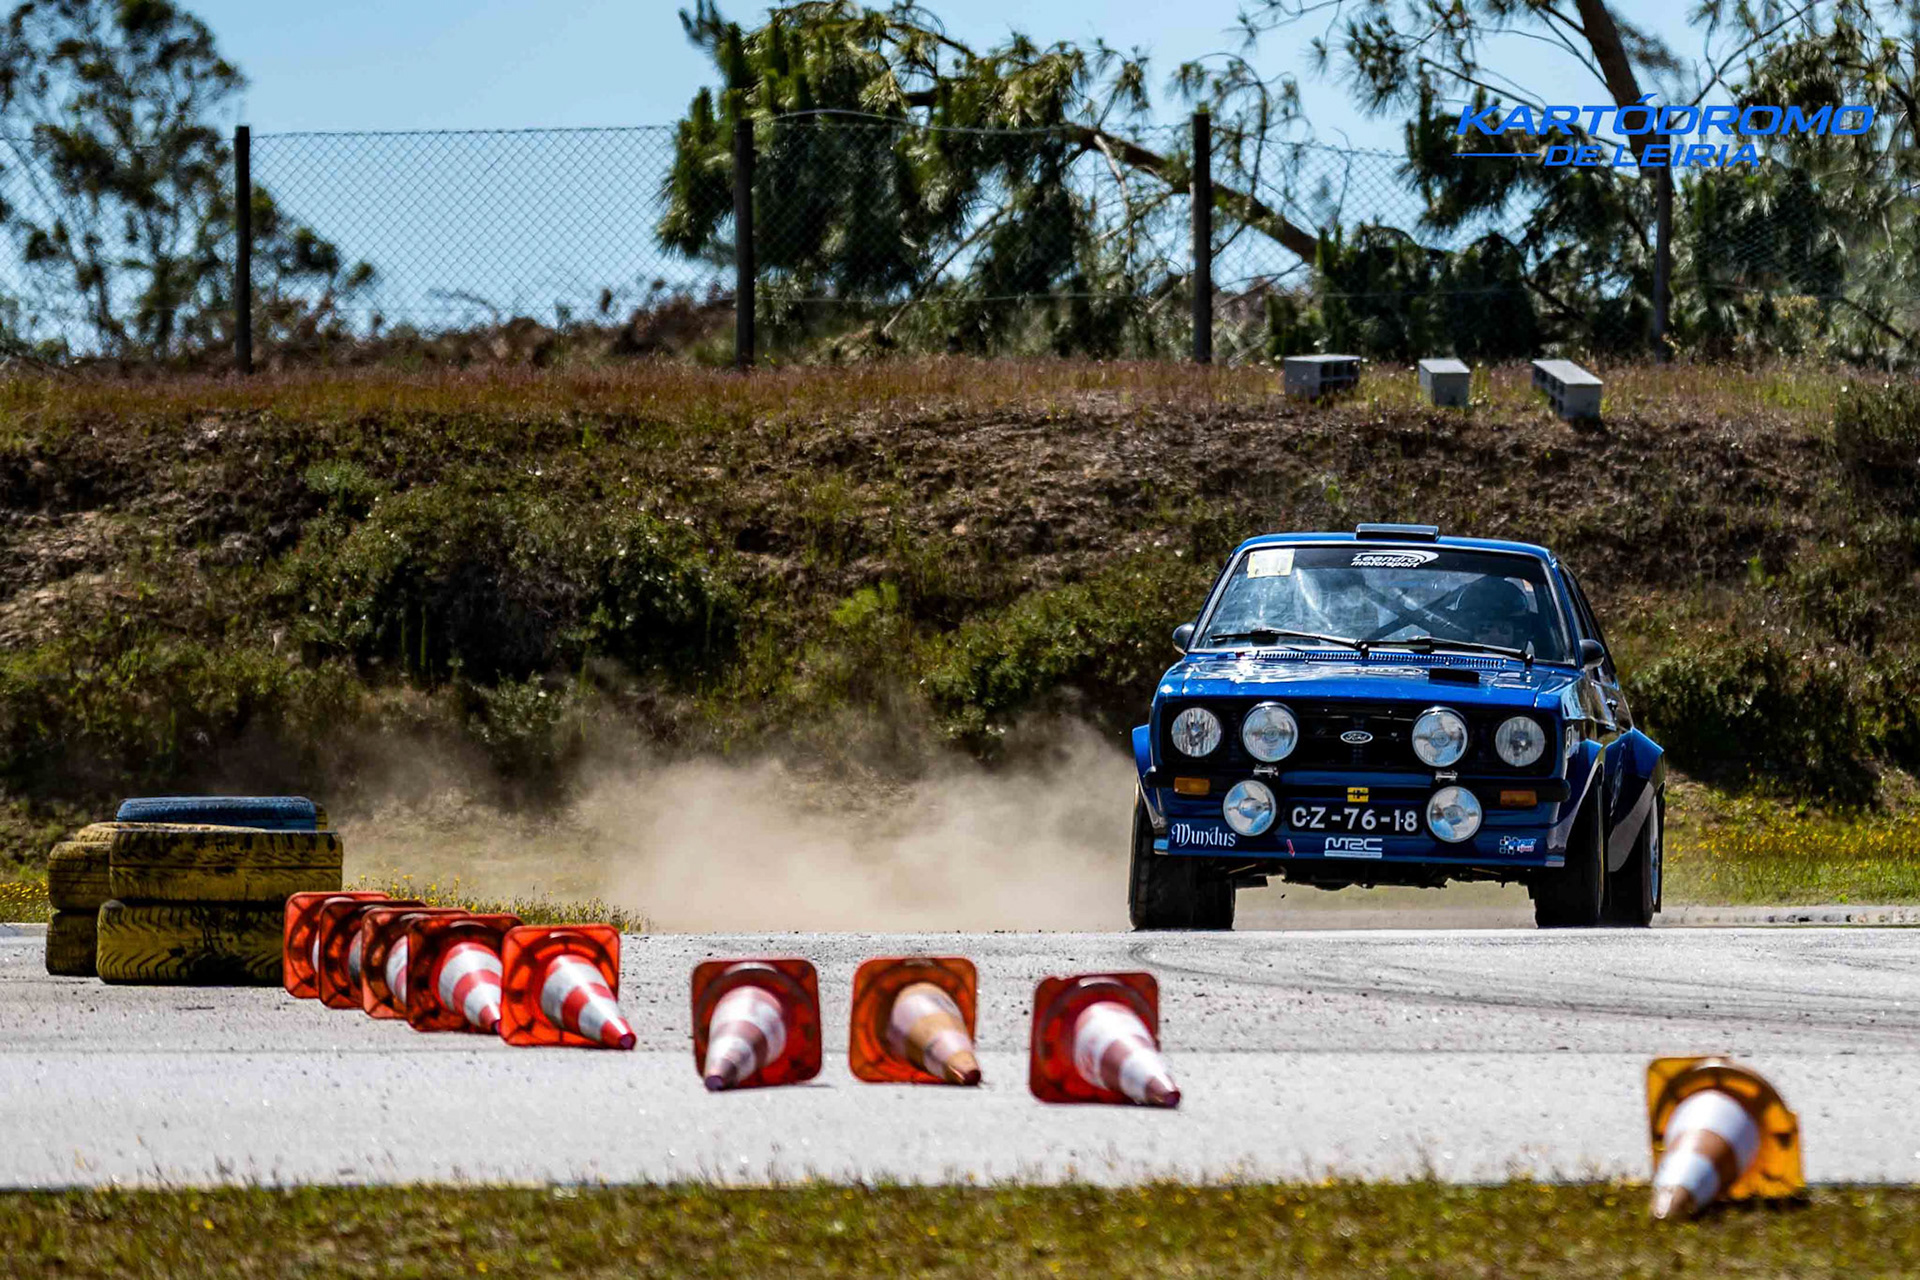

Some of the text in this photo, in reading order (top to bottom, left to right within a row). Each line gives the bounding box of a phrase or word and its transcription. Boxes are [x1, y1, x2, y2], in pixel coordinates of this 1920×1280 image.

[1350, 560, 1420, 568] motorsport
[1352, 553, 1420, 563] Leandro
[1291, 806, 1418, 832] CZ-76-18
[1171, 823, 1237, 847] Mundus
